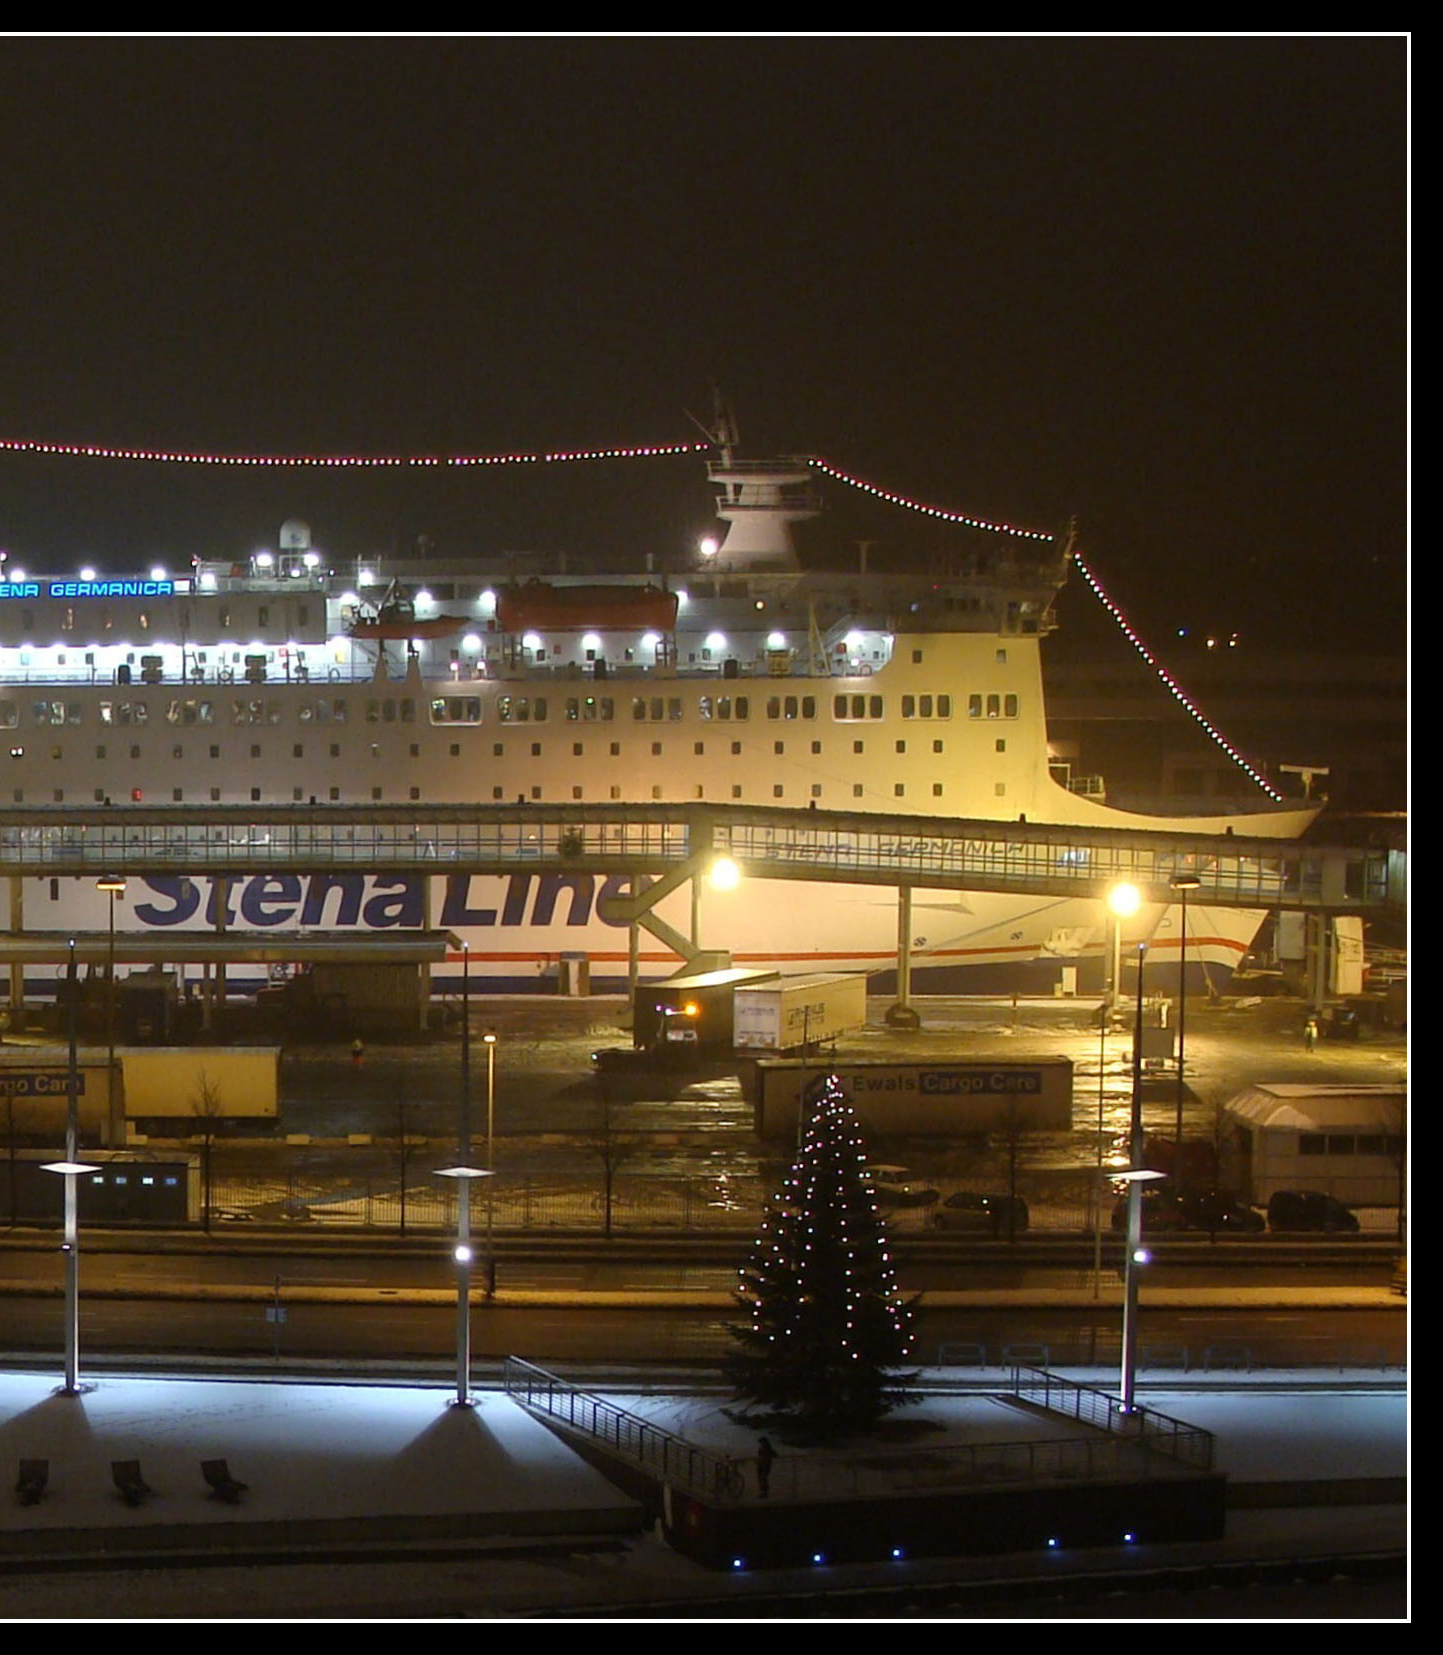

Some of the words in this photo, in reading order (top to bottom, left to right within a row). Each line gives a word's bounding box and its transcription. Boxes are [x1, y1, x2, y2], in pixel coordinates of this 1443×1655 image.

[50, 581, 172, 598] GERMANICA
[852, 1075, 916, 1091] Ewals
[924, 1074, 983, 1093] Cargo
[990, 1073, 1037, 1091] Care
